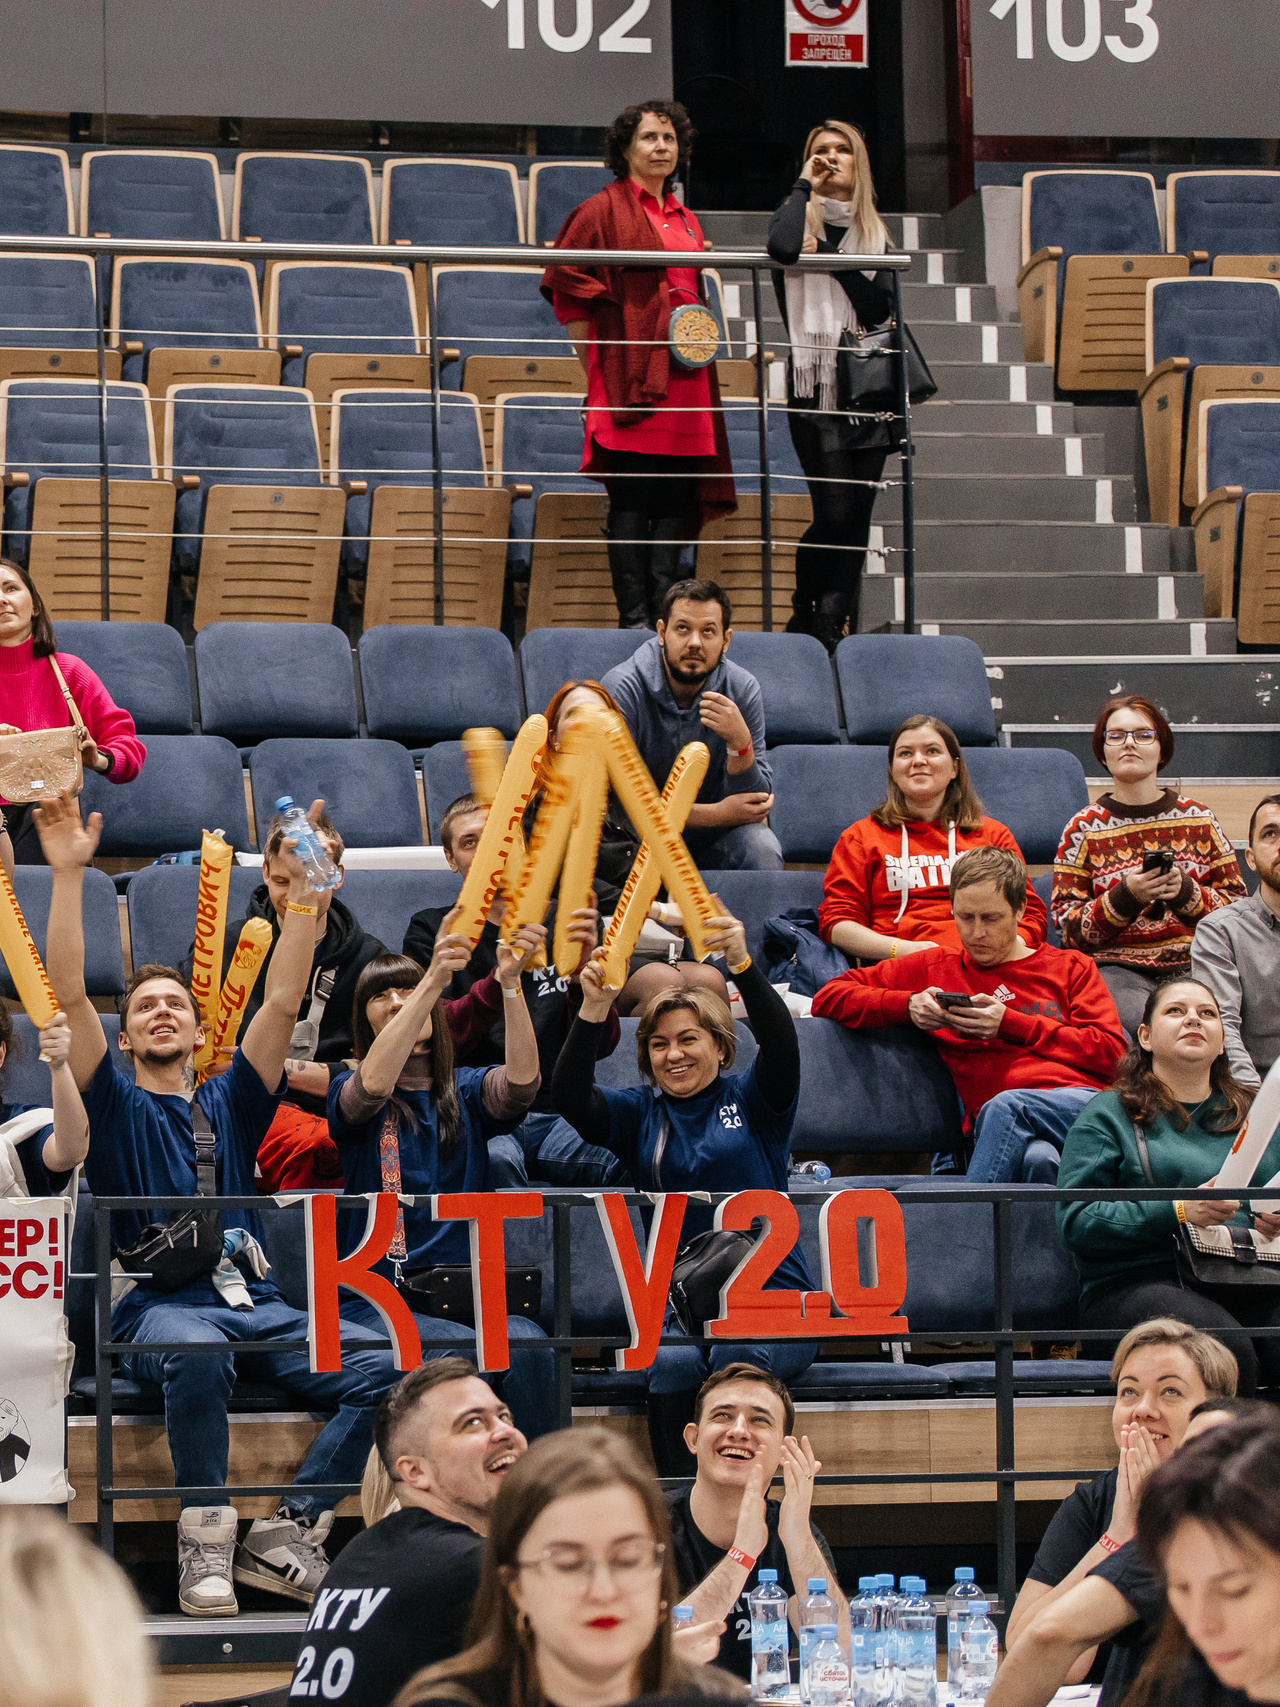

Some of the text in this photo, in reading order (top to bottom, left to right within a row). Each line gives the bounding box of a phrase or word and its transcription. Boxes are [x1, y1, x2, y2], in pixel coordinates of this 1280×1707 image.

[481, 0, 653, 54] 102
[807, 34, 846, 48] ПРОХОД
[989, 0, 1160, 63] 103
[802, 48, 852, 61] ЗАПРЕЩЕН
[538, 976, 569, 997] 2.0
[719, 1103, 738, 1120] КТУ
[306, 1189, 910, 1373] КТУ 2.0
[306, 1587, 391, 1632] КТУ
[289, 1645, 355, 1700] 2.0
